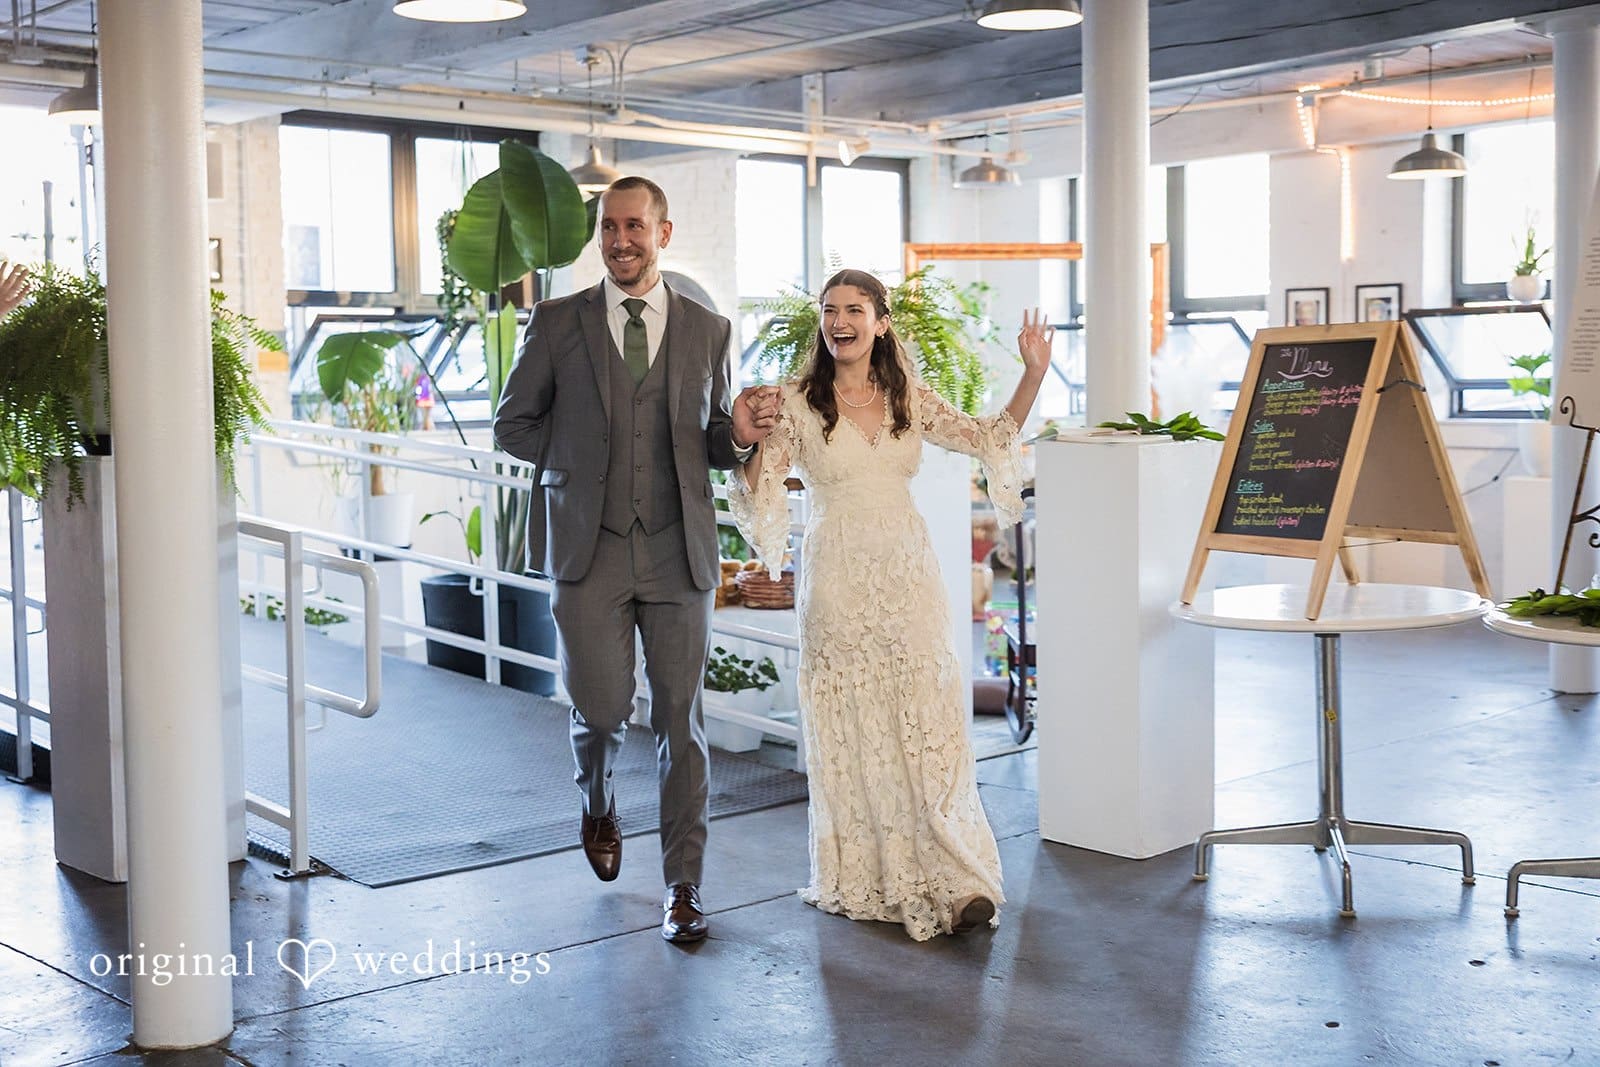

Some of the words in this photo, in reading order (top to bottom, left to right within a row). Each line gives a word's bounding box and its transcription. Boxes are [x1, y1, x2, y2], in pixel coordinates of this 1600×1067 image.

[1289, 346, 1330, 374] Menu
[1262, 378, 1305, 392] Appetizers
[1253, 419, 1275, 433] Sides
